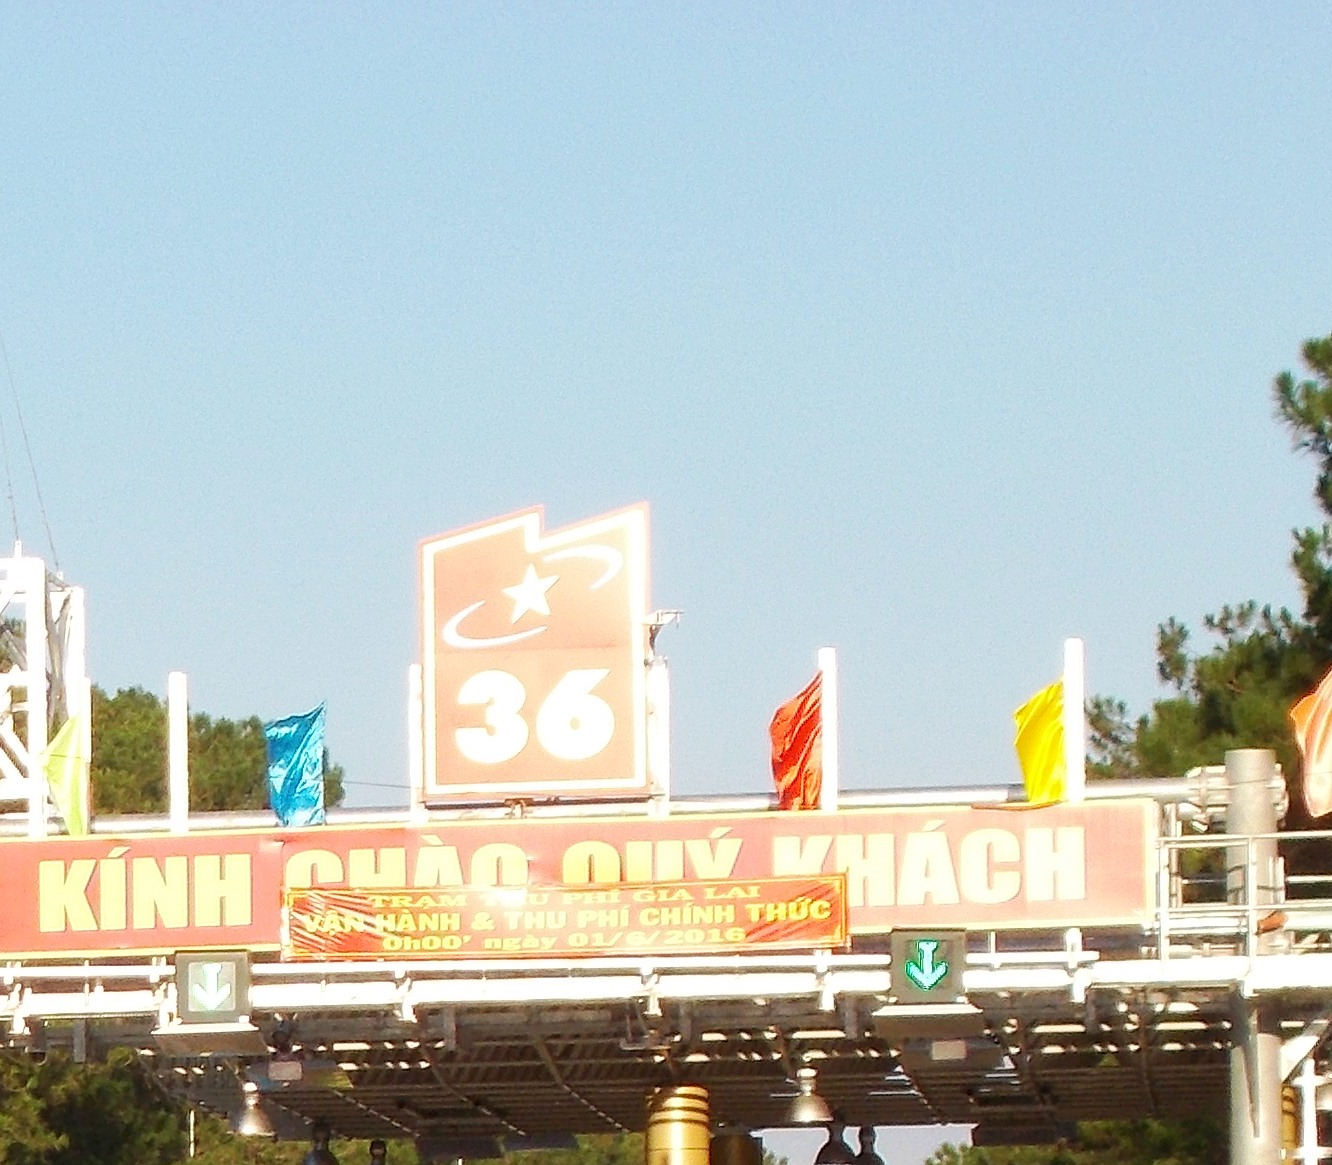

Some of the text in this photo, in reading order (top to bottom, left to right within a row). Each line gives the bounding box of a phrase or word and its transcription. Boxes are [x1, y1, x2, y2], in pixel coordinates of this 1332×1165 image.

[455, 668, 616, 764] 36
[38, 847, 254, 932] KÍNH
[772, 821, 1086, 907] KHÁCH
[633, 887, 693, 902] GIA
[704, 886, 761, 899] LAI
[376, 910, 460, 932] HÀNH
[471, 912, 496, 931] &
[504, 911, 567, 930] THU
[577, 905, 629, 928] PHÍ
[639, 902, 735, 926] CHÍNH
[745, 897, 832, 923] THỨC
[483, 935, 557, 951] ngày
